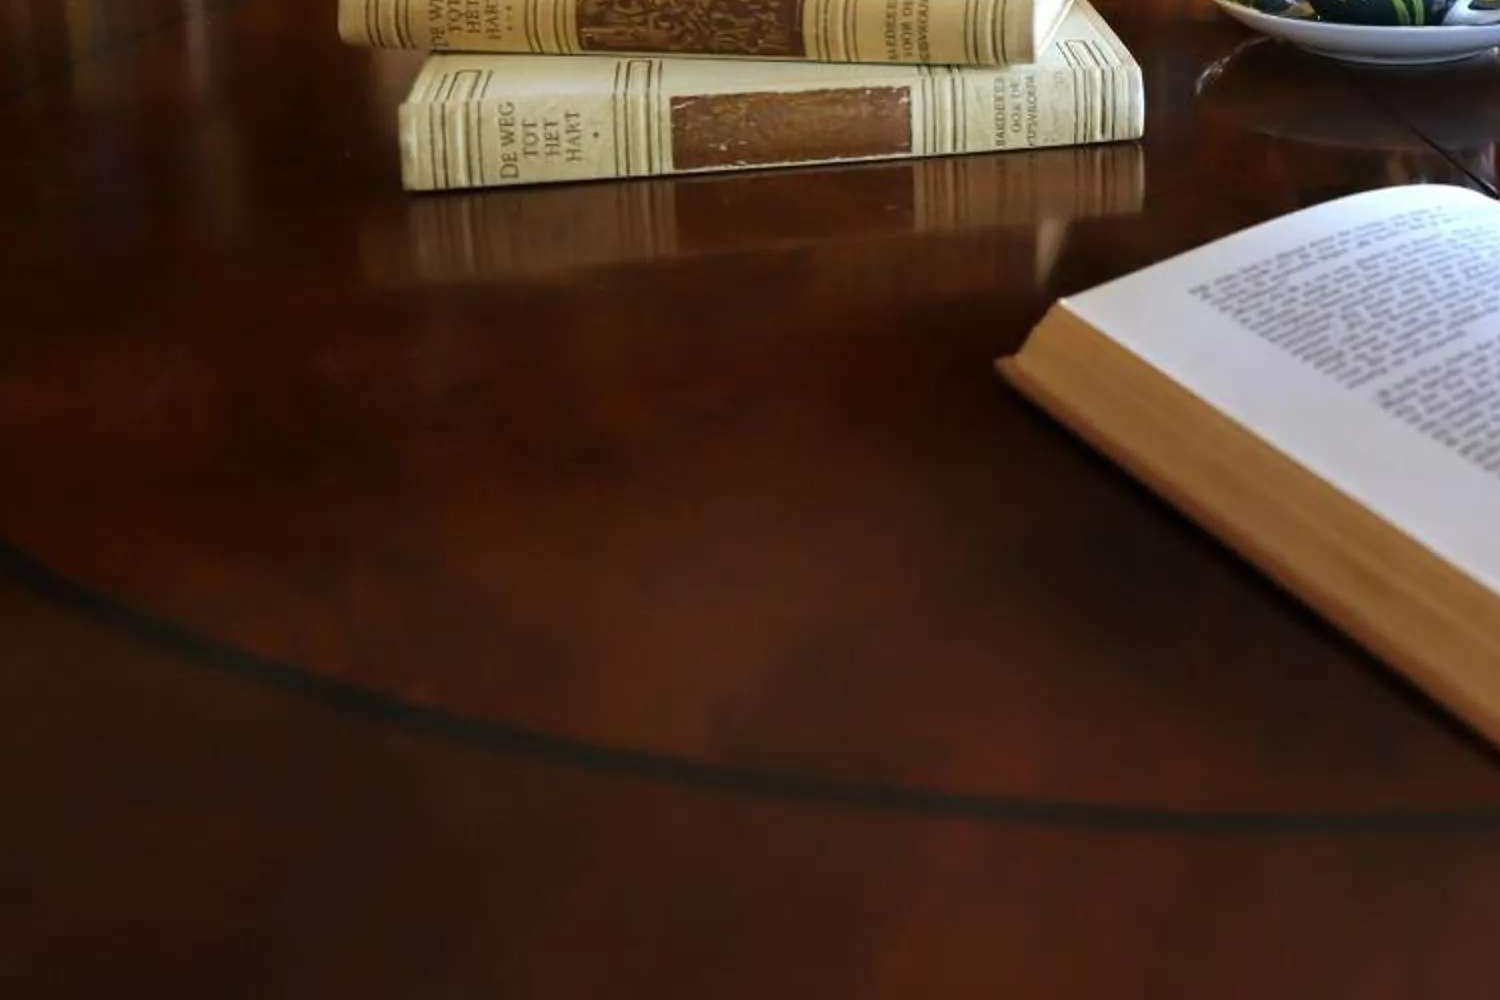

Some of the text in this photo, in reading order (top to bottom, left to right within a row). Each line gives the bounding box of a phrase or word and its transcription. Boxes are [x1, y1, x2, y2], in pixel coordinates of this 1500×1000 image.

[430, 26, 449, 49] DE
[498, 101, 519, 179] DE WEG
[521, 118, 540, 157] TOT
[543, 118, 560, 157] HET
[564, 109, 582, 162] HART
